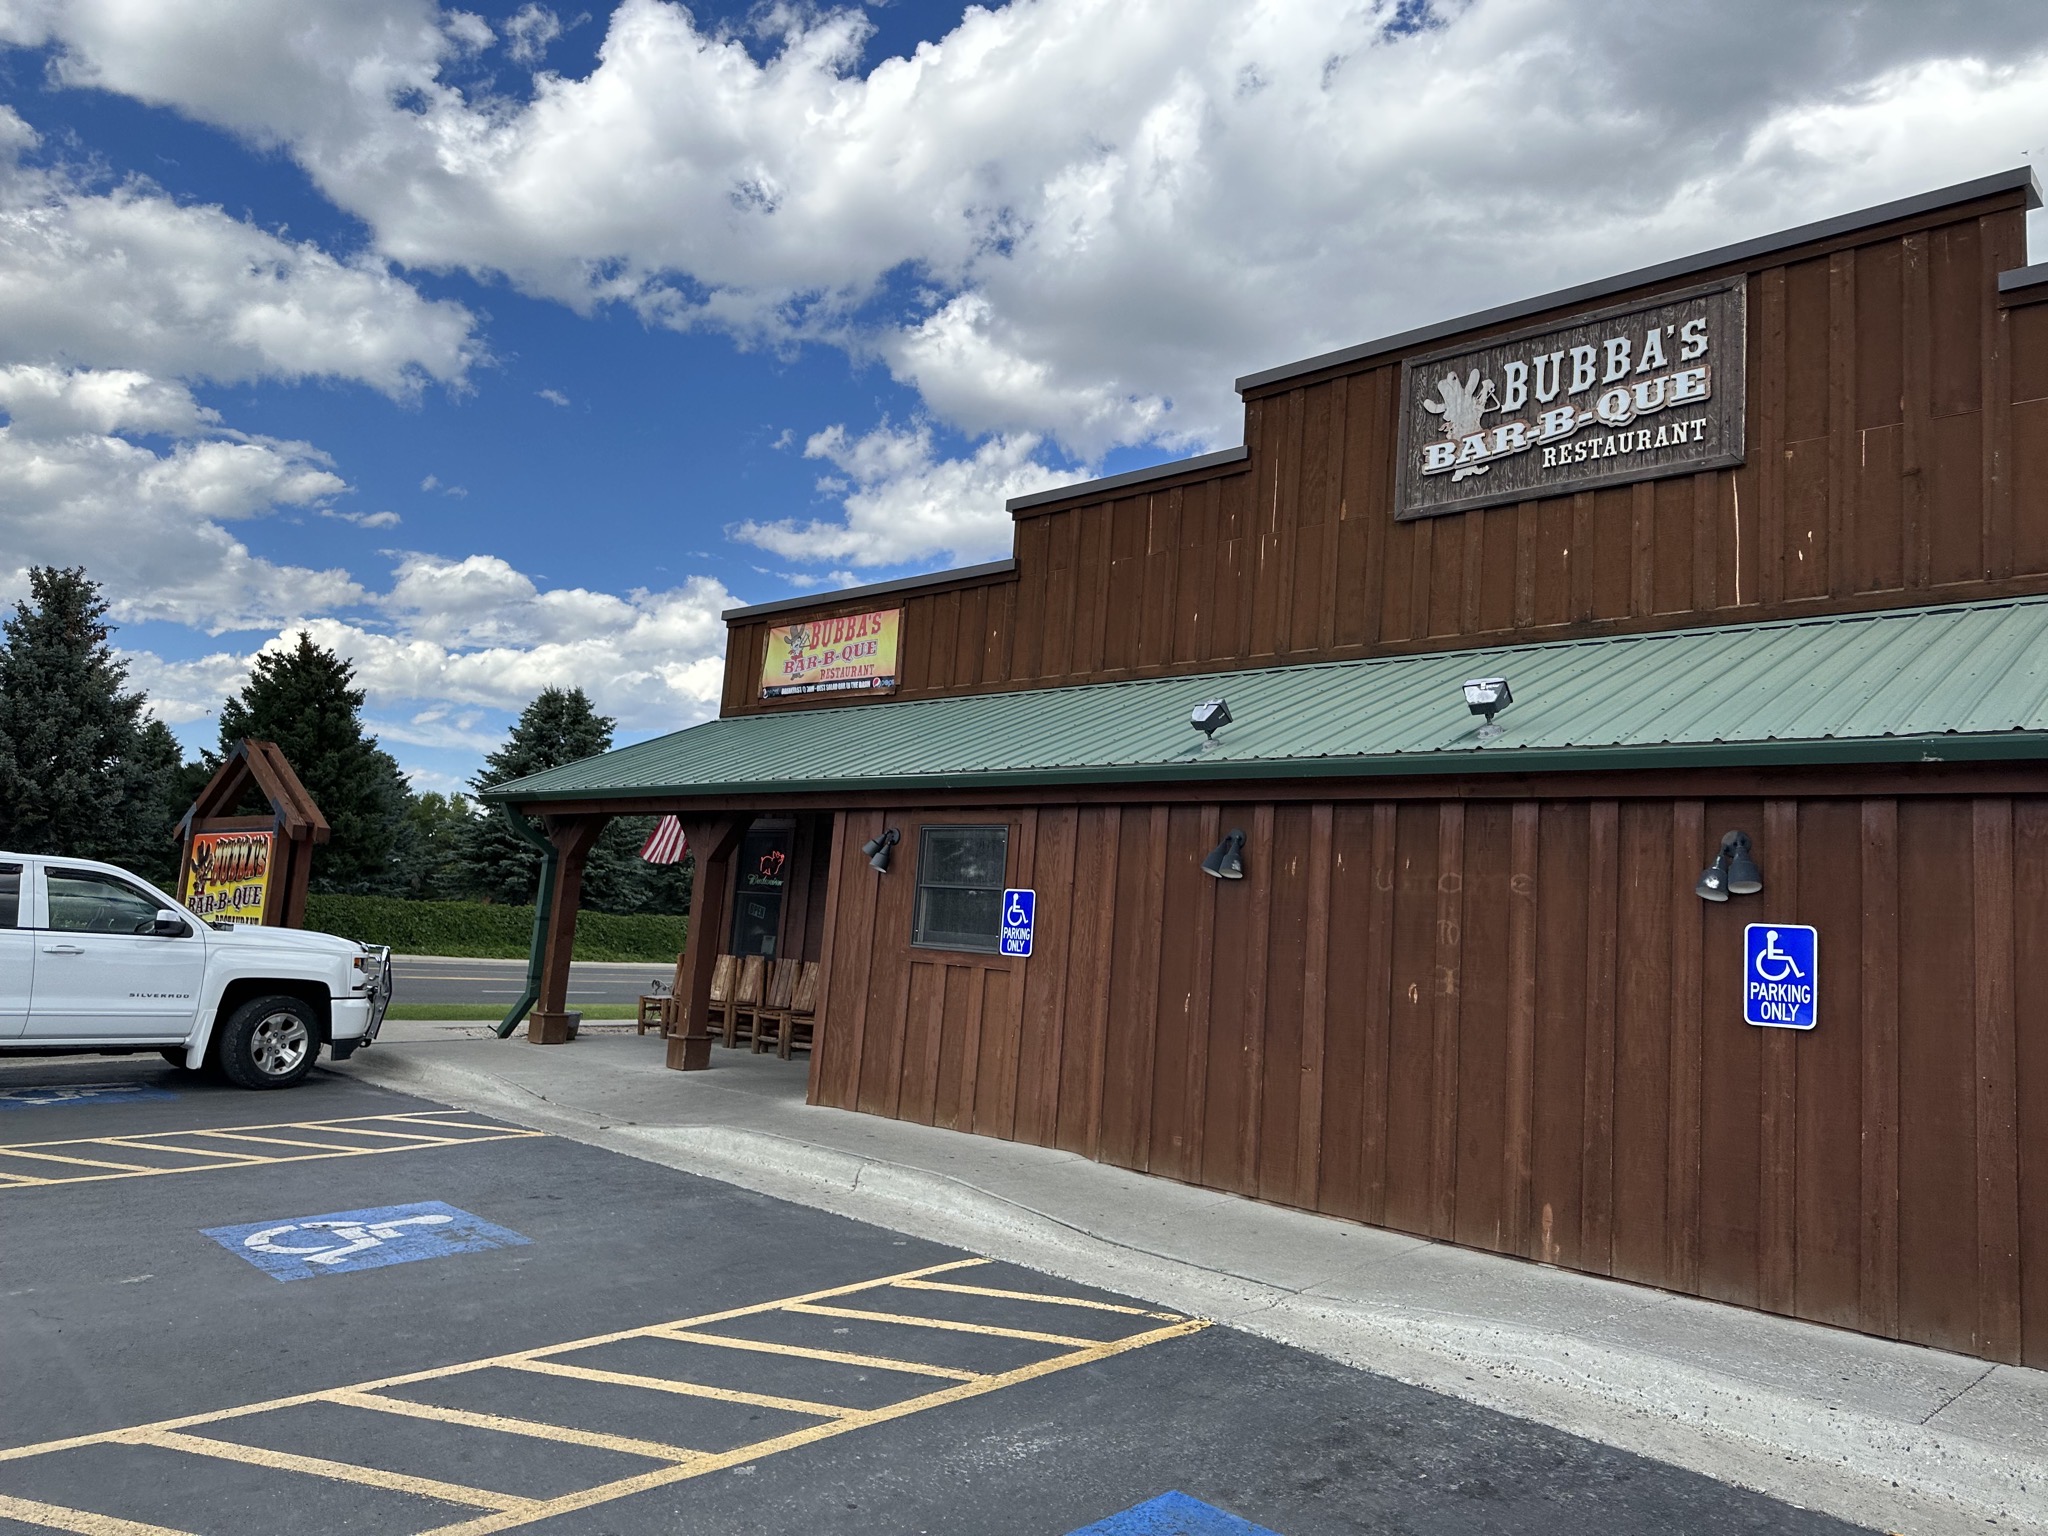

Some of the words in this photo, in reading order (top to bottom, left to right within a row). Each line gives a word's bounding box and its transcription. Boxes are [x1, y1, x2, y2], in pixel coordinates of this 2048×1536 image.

[1501, 317, 1709, 414] BUBBA'S
[1424, 366, 1709, 473] BAR-B-QUE
[1542, 418, 1707, 468] RESTAURANT
[809, 612, 882, 650] BUBBA'S
[783, 640, 878, 674] BAR-B-QUE
[820, 664, 875, 680] RESTAURANT
[210, 834, 270, 887] BUBBA'S
[187, 885, 263, 915] BAR-B-QUE
[1003, 926, 1031, 941] PARKING
[1006, 939, 1026, 952] ONLY
[1750, 981, 1811, 1004] PARKING
[1760, 1001, 1800, 1021] ONLY
